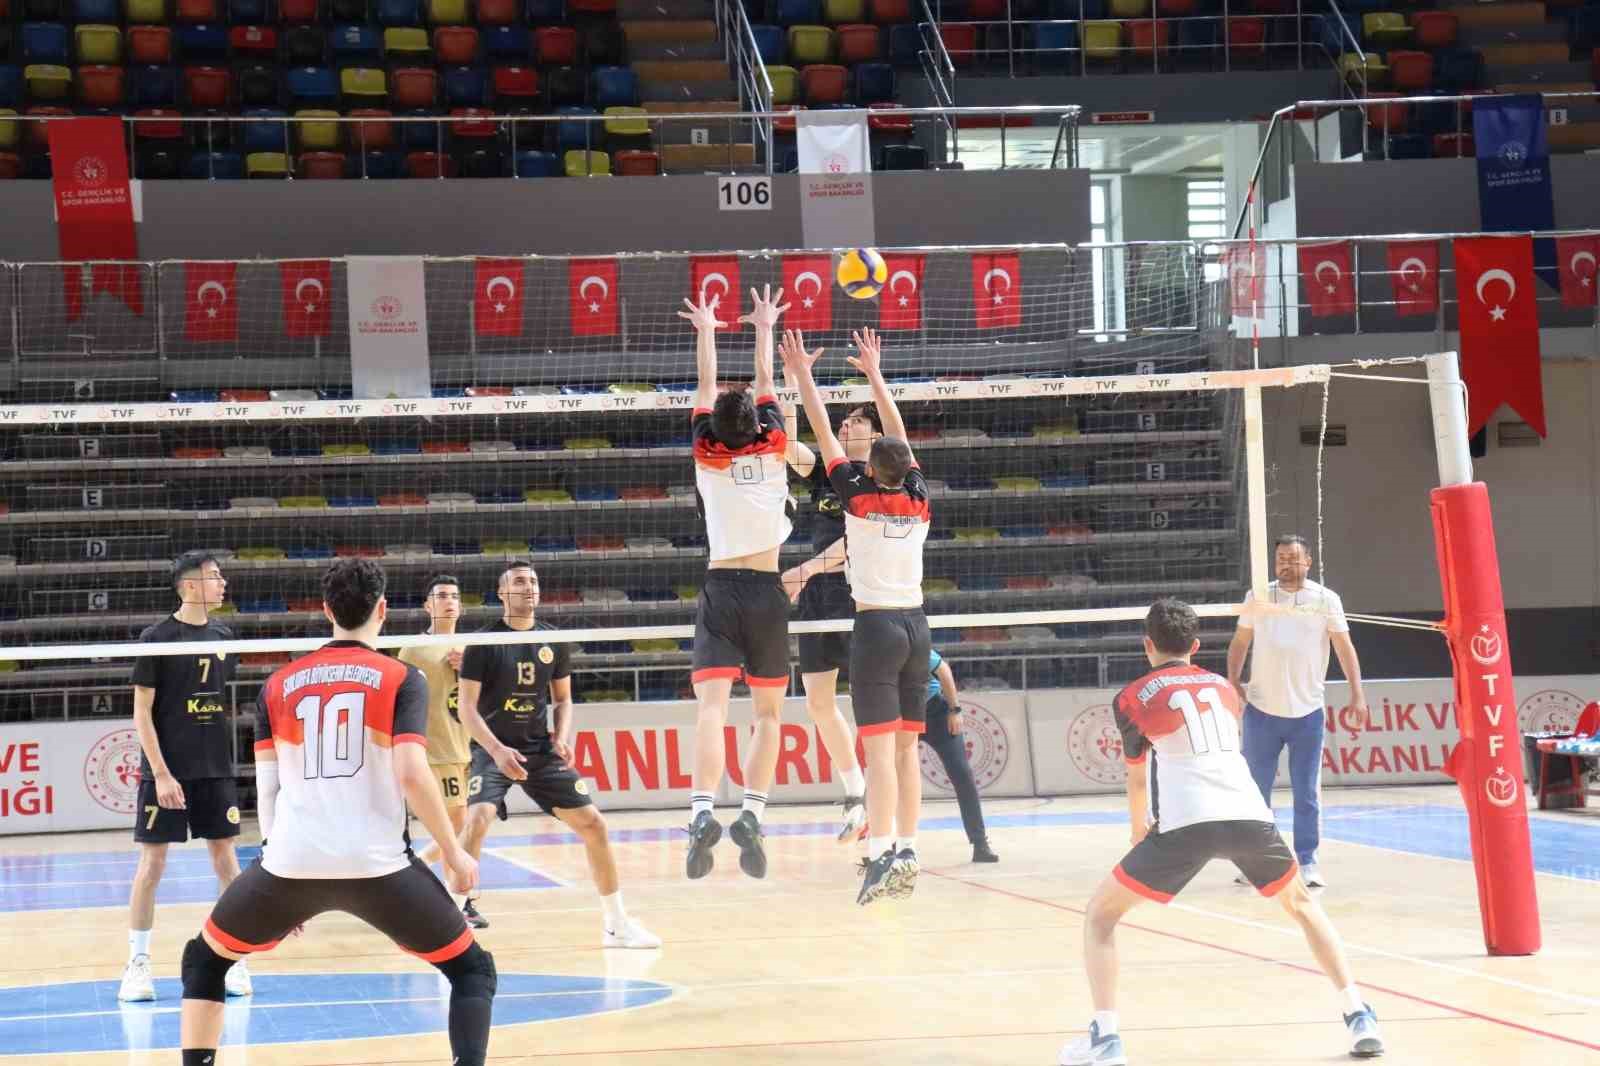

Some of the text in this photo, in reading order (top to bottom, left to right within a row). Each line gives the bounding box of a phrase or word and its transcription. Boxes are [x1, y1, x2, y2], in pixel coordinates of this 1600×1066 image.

[721, 181, 769, 205] 106
[0, 410, 18, 420] VF
[51, 409, 77, 419] TVF
[110, 408, 135, 418] TVF
[167, 407, 193, 417] TVF
[224, 406, 249, 417] TVF
[281, 405, 306, 416] TVF
[338, 404, 362, 415] TVF
[392, 403, 417, 414] TVF
[448, 401, 473, 412] TVF
[504, 400, 528, 411] TVF
[558, 399, 583, 410] TVF
[613, 396, 637, 407] TVF
[667, 395, 691, 406] TVF
[775, 391, 799, 402] TVF
[828, 389, 853, 400] TVF
[887, 387, 905, 398] VF
[935, 385, 959, 396] TVF
[989, 383, 1013, 394] TVF
[1041, 382, 1065, 393] TVF
[1095, 380, 1118, 391] TVF
[1148, 378, 1171, 389] TVF
[87, 491, 97, 506] E
[91, 541, 102, 556] D
[93, 593, 105, 608] C
[199, 658, 211, 683] 7
[517, 661, 535, 685] 13
[1168, 687, 1233, 755] 11
[1481, 673, 1503, 758] TVF
[295, 691, 367, 779] 10
[441, 776, 460, 798] 16
[144, 805, 160, 830] 7
